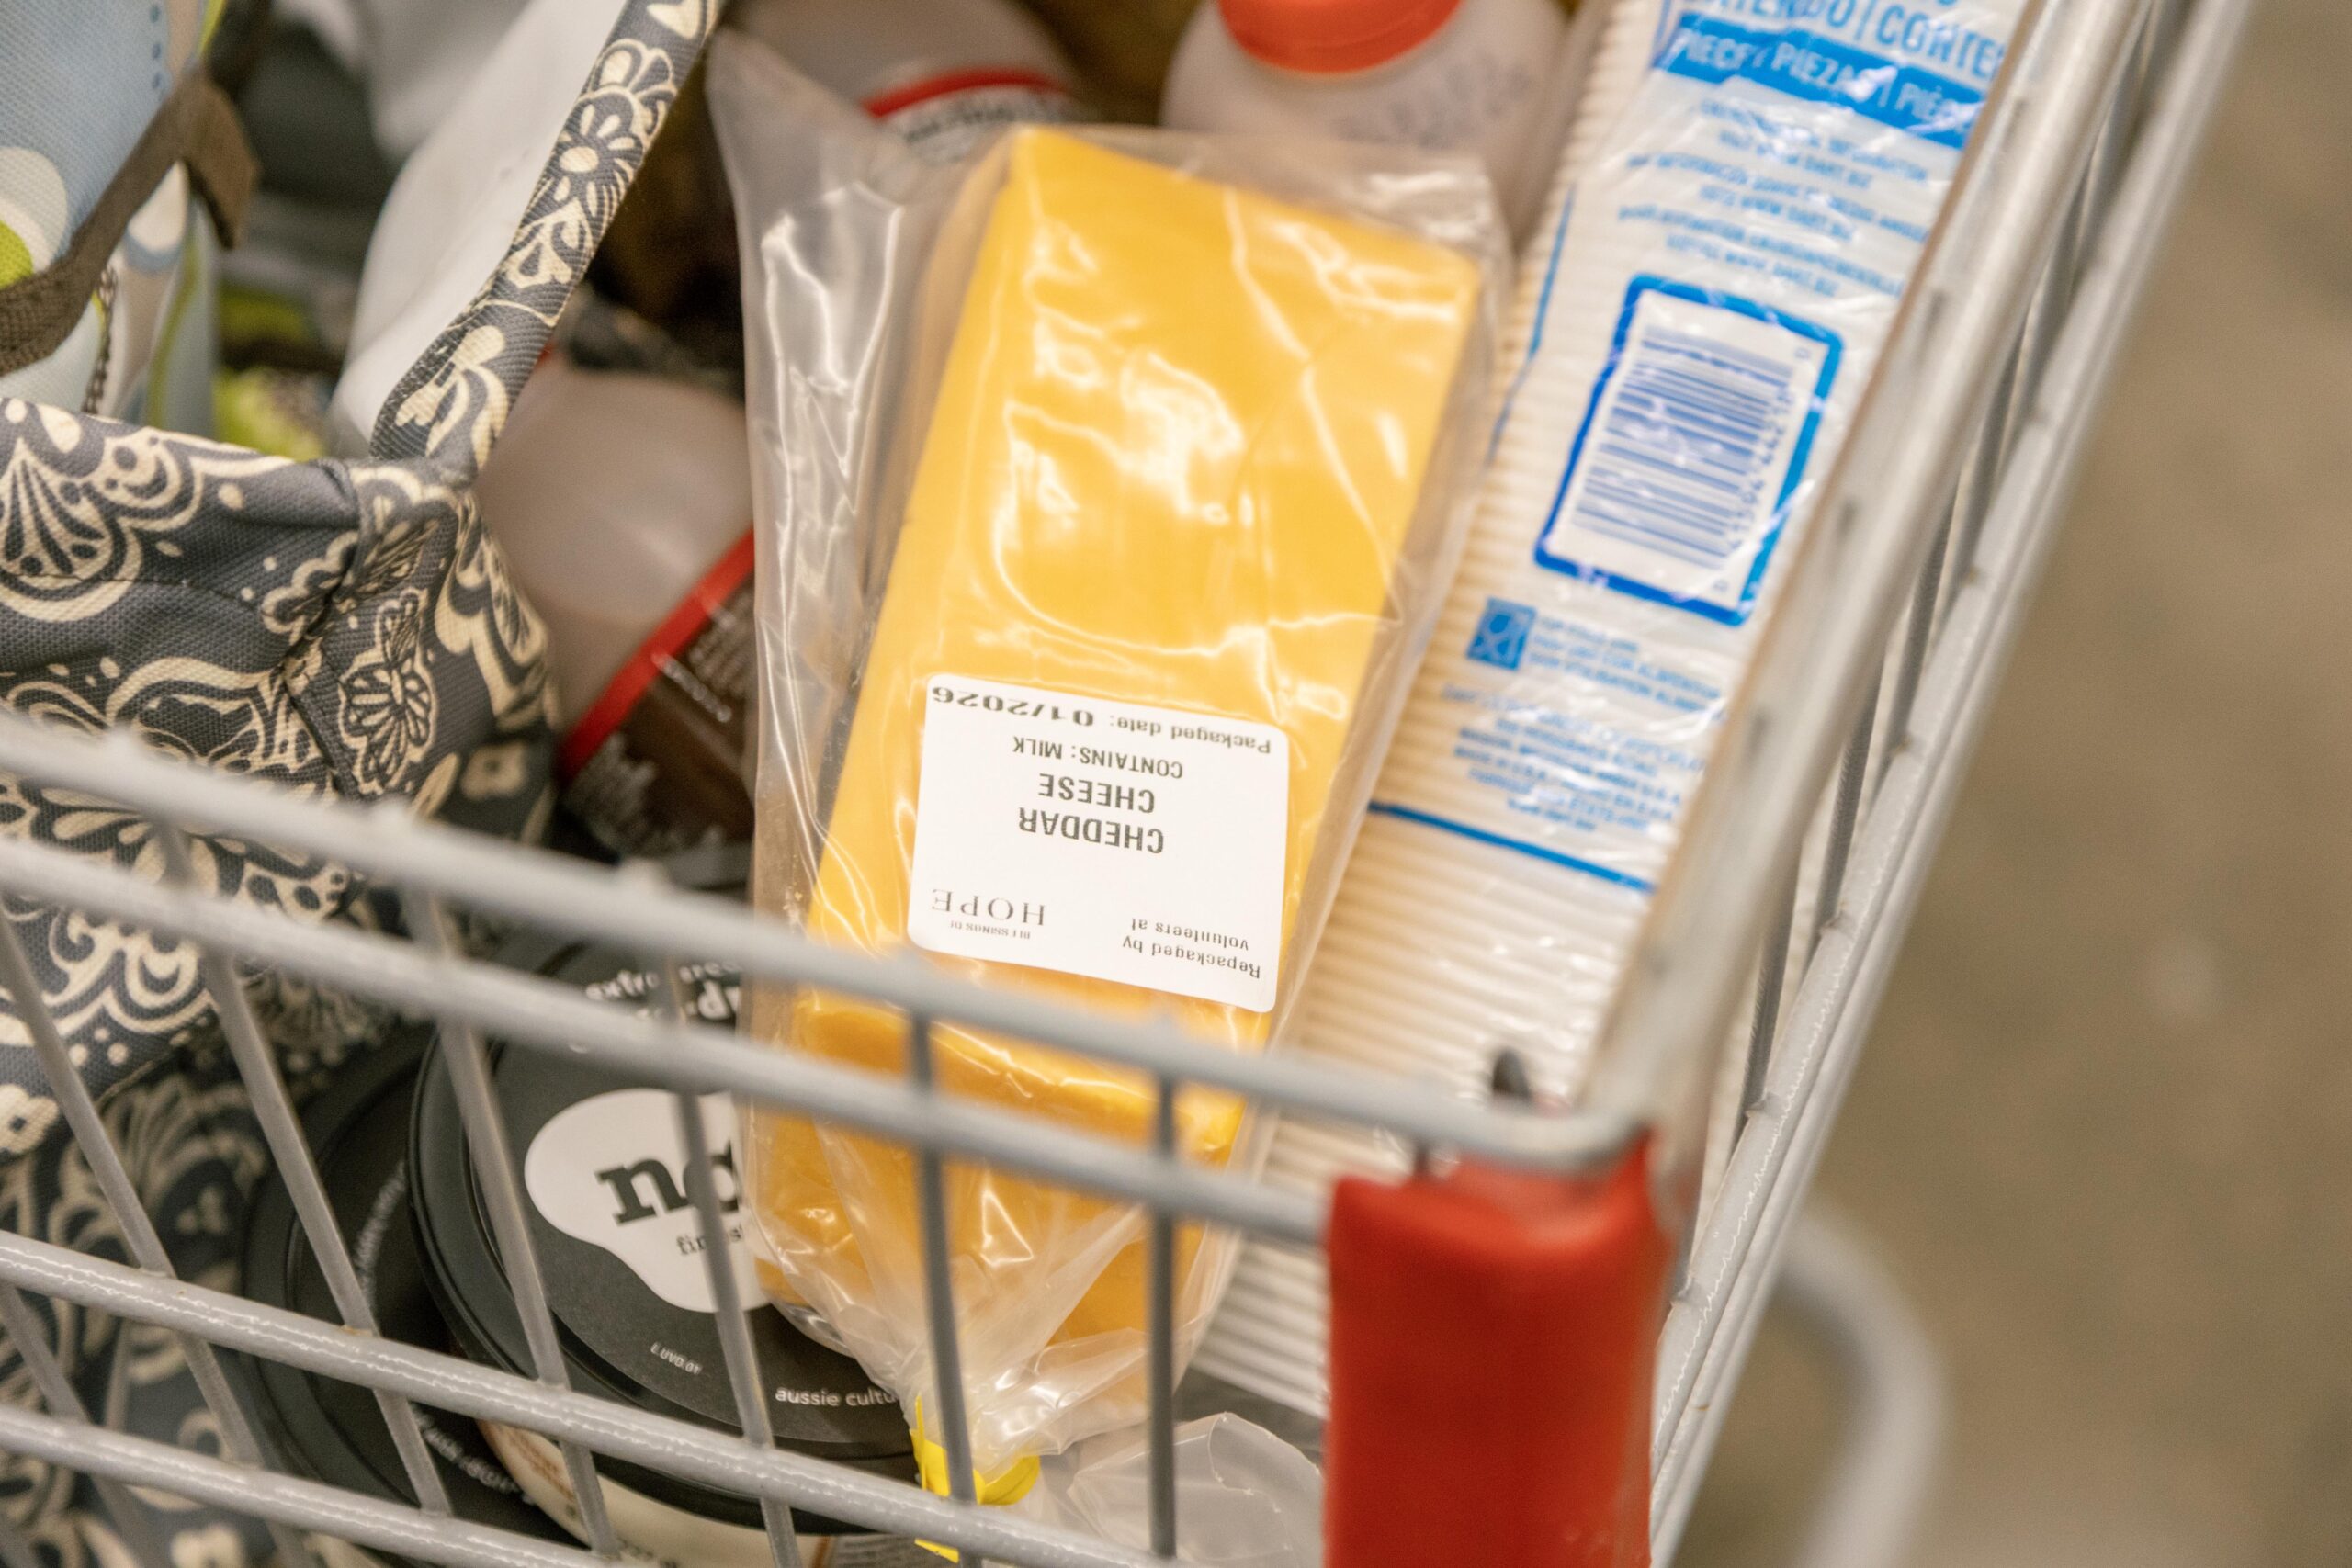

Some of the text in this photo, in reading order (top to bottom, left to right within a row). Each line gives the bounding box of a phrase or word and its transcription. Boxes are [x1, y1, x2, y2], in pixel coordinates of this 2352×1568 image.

[931, 686, 1272, 755] Packaged date: 01/2026
[1012, 736, 1184, 780] CONTAINS: MILK
[1037, 773, 1156, 814] CHEESE
[1018, 807, 1165, 854] CHEDDAR
[931, 888, 1046, 927] HOPE
[1130, 918, 1250, 952] volunteers at
[1122, 935, 1261, 980] Repackaged by
[775, 1384, 899, 1408] aussie cultu
